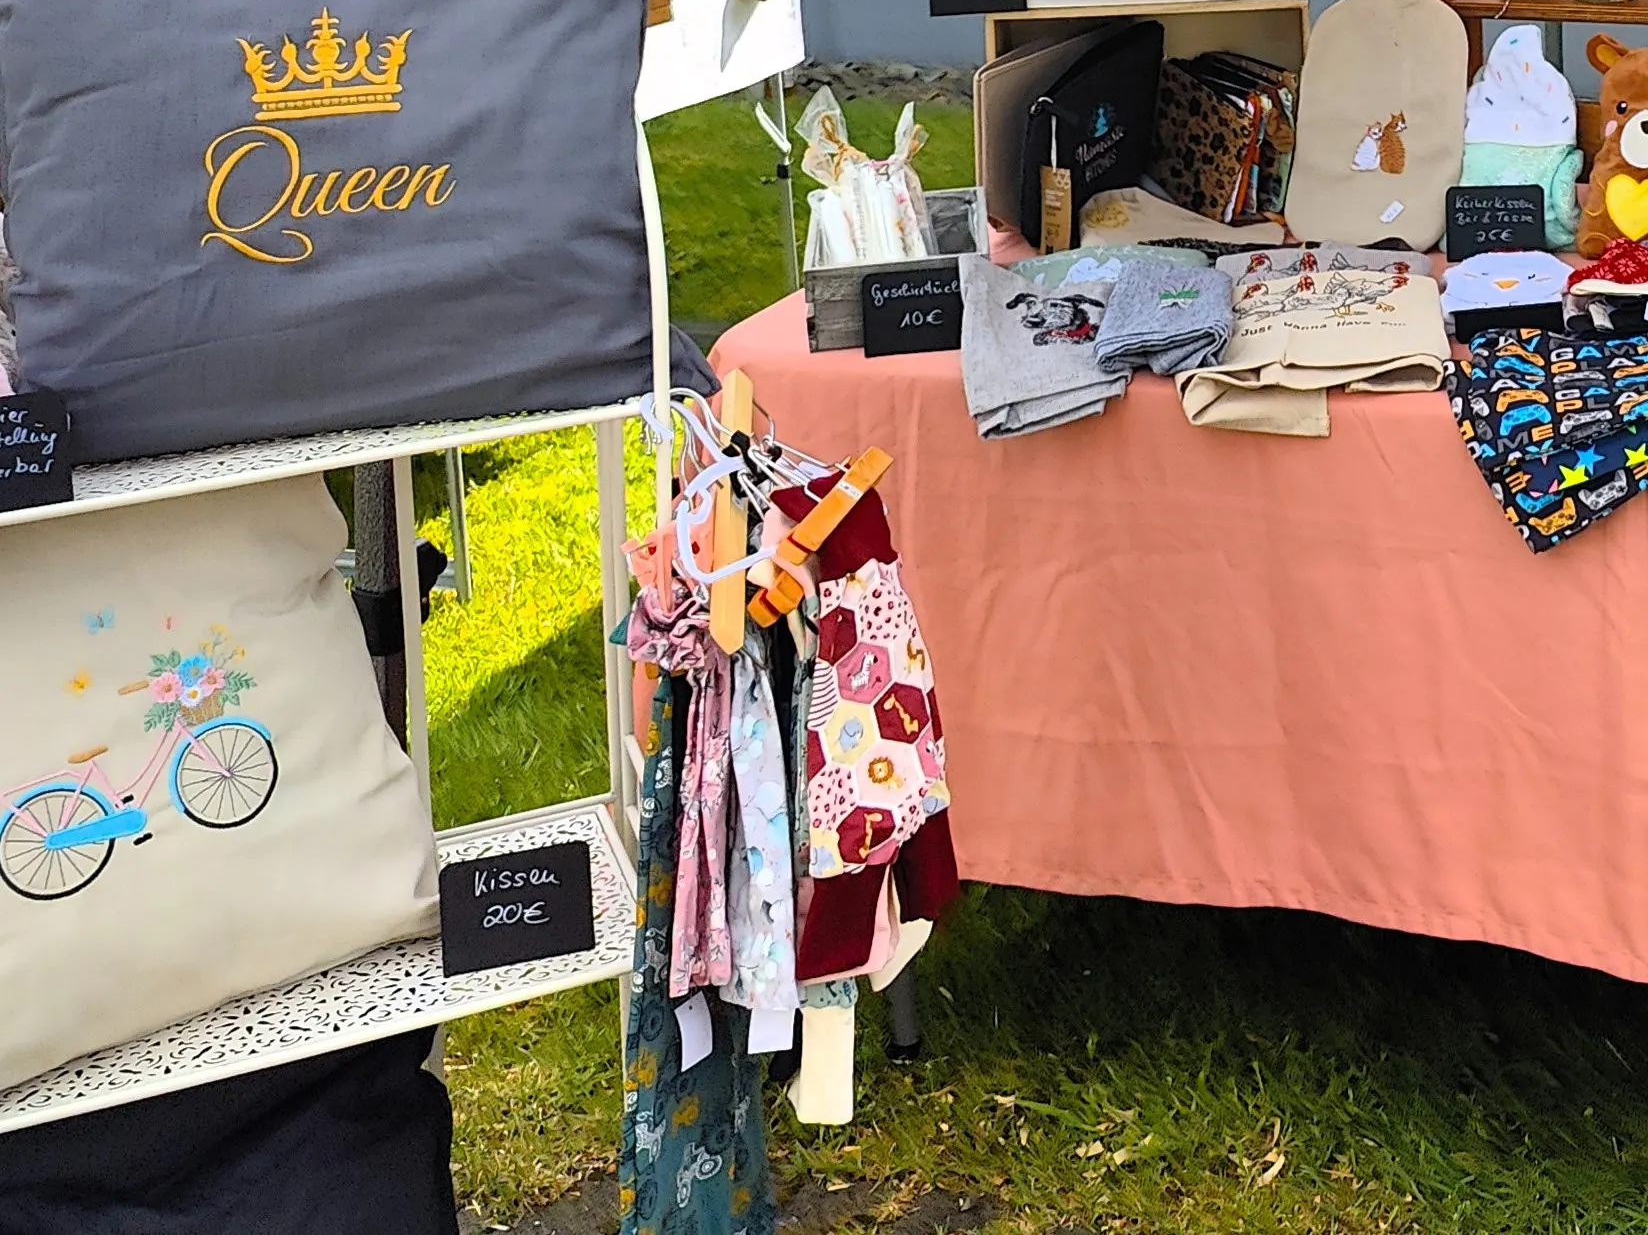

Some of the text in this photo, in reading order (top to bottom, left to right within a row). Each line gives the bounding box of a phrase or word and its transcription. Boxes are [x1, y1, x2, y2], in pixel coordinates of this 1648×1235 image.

[200, 125, 458, 263] Queen
[899, 308, 944, 329] 10€
[1240, 324, 1274, 337] Just
[474, 868, 561, 897] Kissen
[483, 902, 551, 929] 20€
